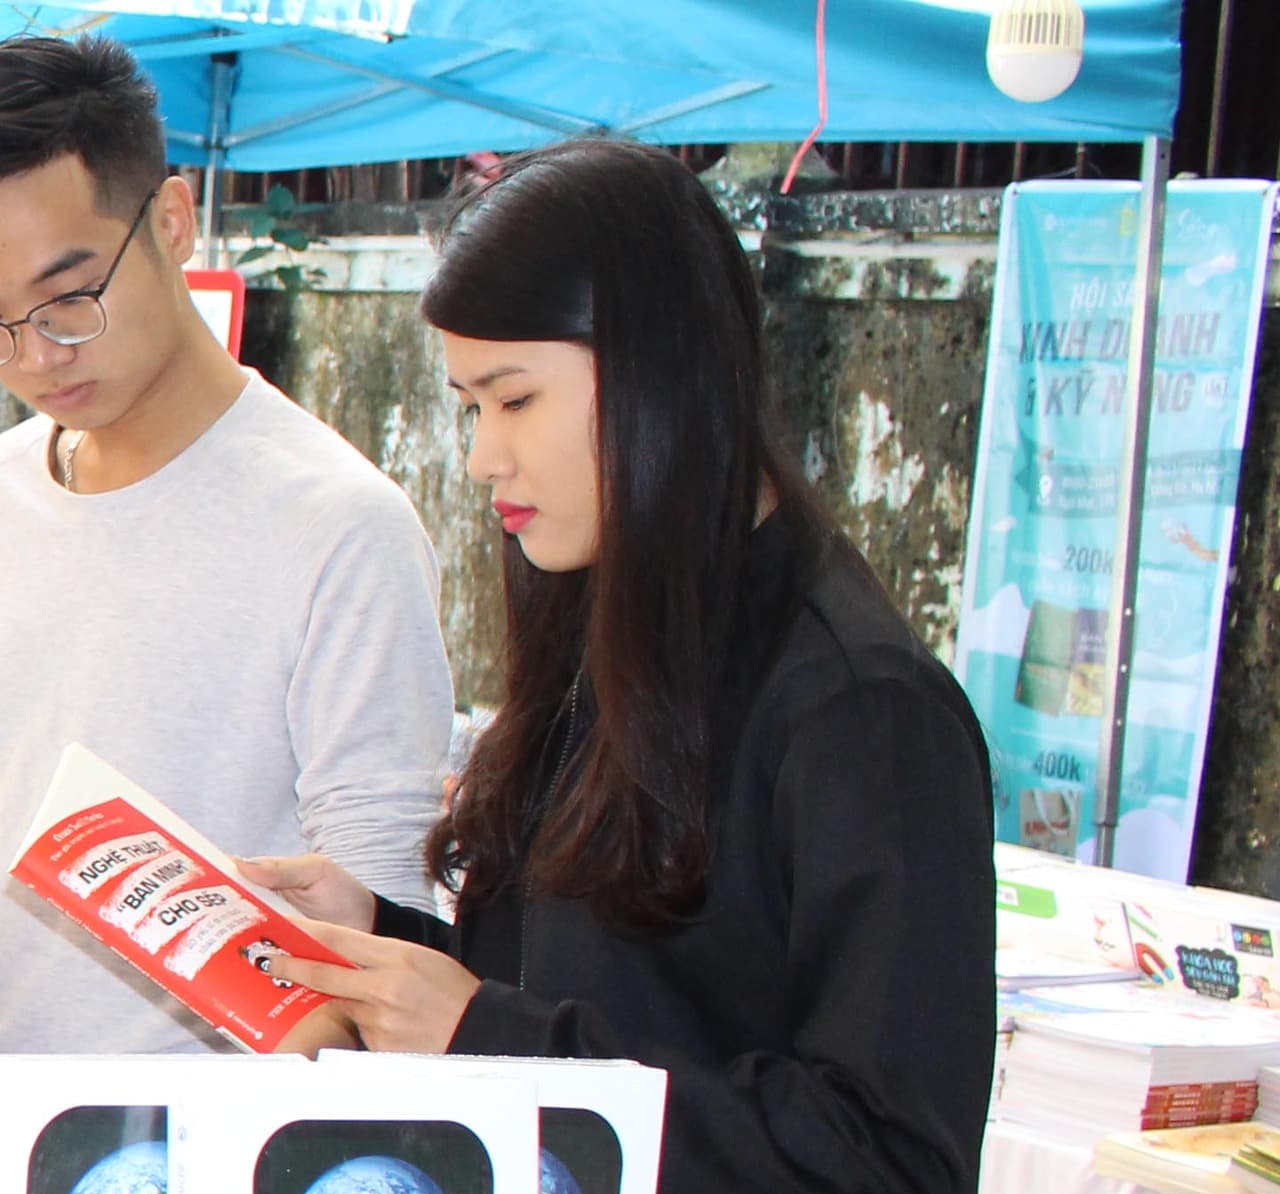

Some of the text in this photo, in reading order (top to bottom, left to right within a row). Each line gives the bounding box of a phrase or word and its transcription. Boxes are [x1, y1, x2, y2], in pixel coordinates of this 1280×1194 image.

[1098, 312, 1220, 361] DANH
[1101, 371, 1196, 415] NNG
[1064, 545, 1114, 575] 200k
[1033, 751, 1081, 781] 400k
[78, 848, 128, 884] NGHỆ
[157, 899, 200, 926] CHO
